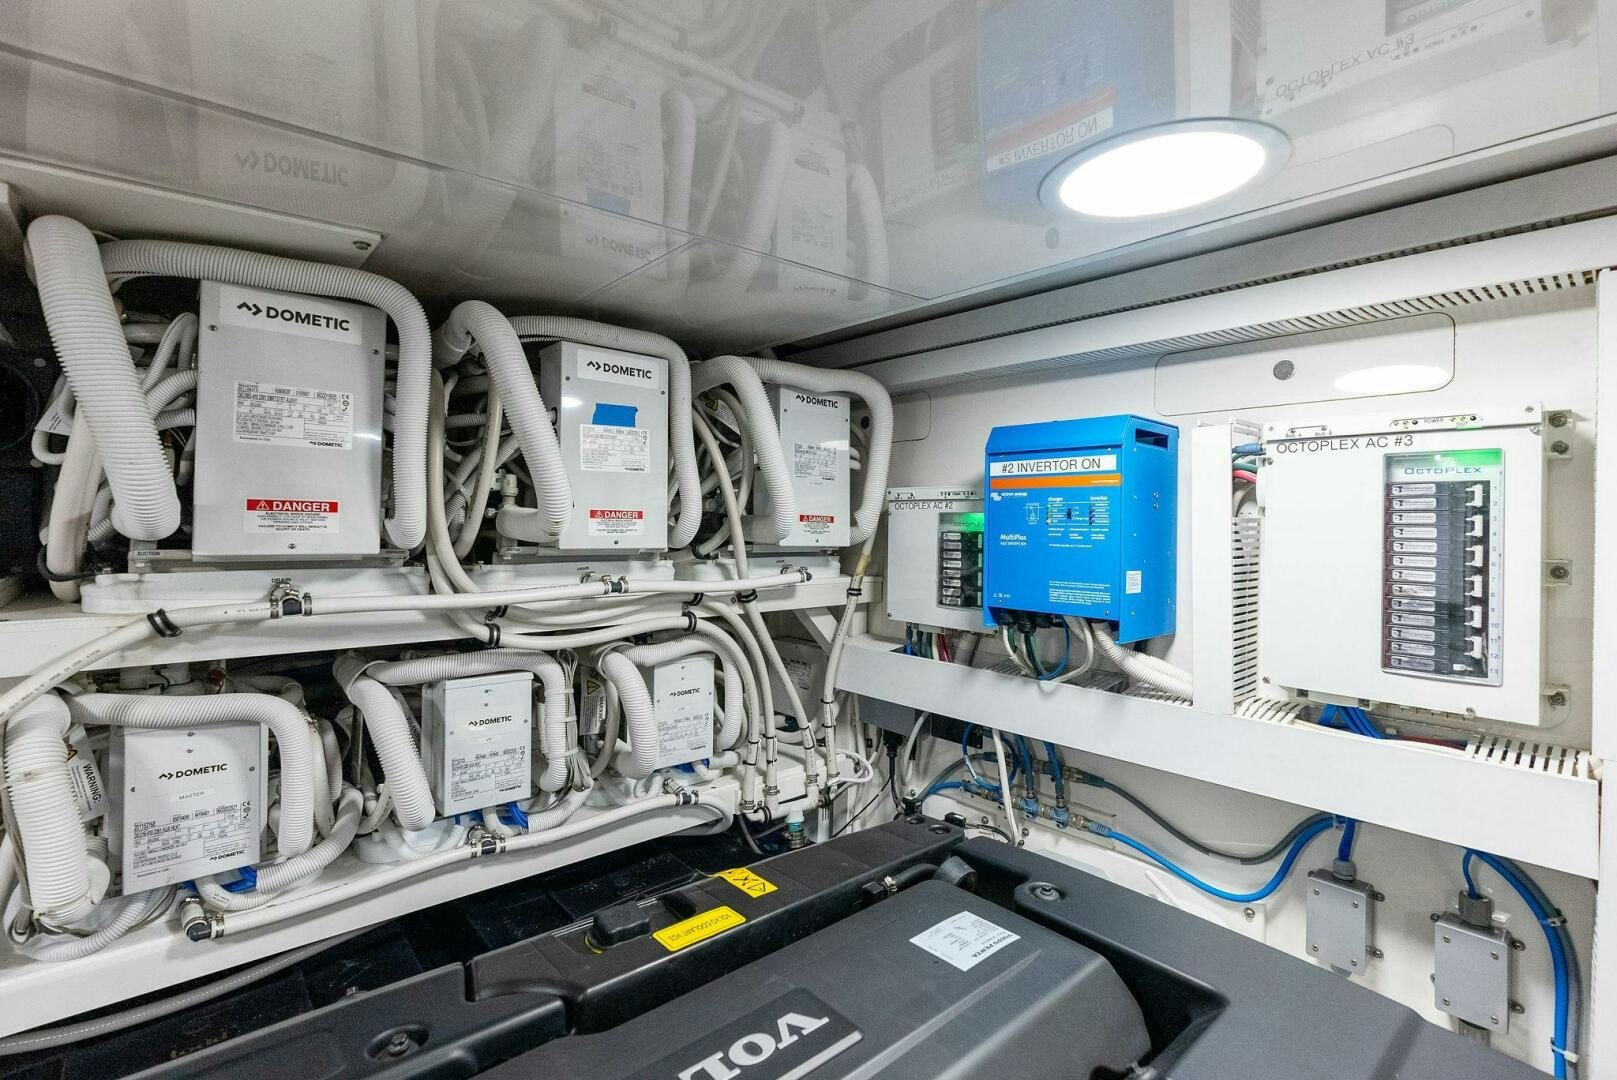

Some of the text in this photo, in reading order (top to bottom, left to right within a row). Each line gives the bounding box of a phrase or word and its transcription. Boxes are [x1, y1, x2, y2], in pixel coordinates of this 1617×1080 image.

[266, 306, 350, 331] DOMETIC
[603, 363, 652, 379] DOMETIC
[806, 396, 838, 408] DOMETIC
[1276, 434, 1414, 454] OCTOPLEX AC #3
[1002, 458, 1101, 474] #2 INVERTOR ON
[272, 501, 330, 512] DANGER
[894, 501, 931, 511] OCTOPLEX
[933, 501, 943, 510] AC
[604, 511, 638, 519] DANGER
[677, 688, 700, 697] DOMETIC
[479, 715, 512, 726] DOMETIC
[175, 763, 228, 779] DOMETIC
[83, 763, 102, 804] WARNING:
[179, 790, 205, 800] MASTER
[218, 849, 245, 860] DOMETIC
[971, 943, 994, 958] PENTA
